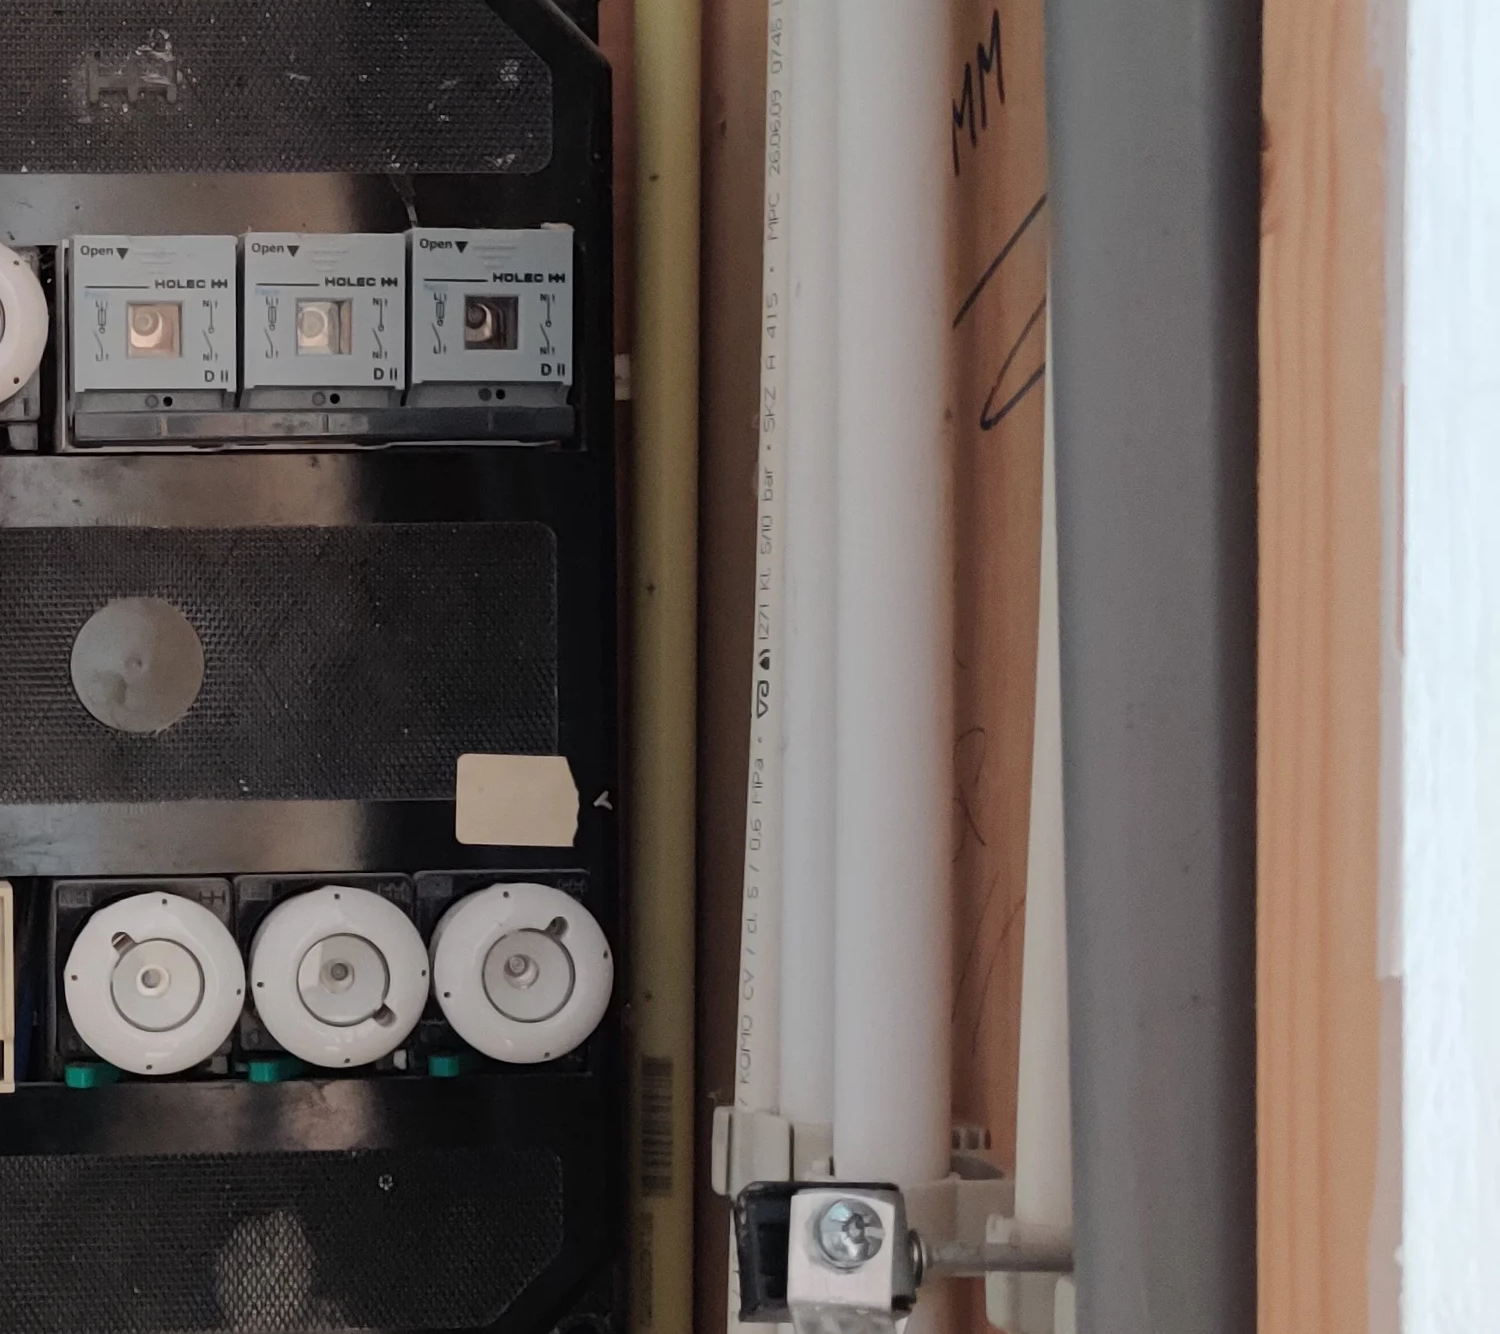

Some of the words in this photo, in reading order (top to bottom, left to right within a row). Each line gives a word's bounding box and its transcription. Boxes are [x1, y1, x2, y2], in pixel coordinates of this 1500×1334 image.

[767, 191, 780, 241] MPC
[80, 244, 114, 258] Open
[251, 242, 285, 256] Open
[419, 238, 453, 253] Open
[154, 279, 205, 290] HOLEC
[324, 276, 376, 287] HOLEC
[492, 272, 544, 284] HOLEC
[766, 292, 778, 339] 415
[204, 370, 214, 383] D
[373, 367, 384, 381] D
[540, 363, 552, 377] D
[763, 385, 776, 433] SKZ
[761, 466, 774, 502] bar
[751, 758, 764, 804] MPa
[742, 968, 755, 1001] CV
[739, 1014, 753, 1085] KOMO
